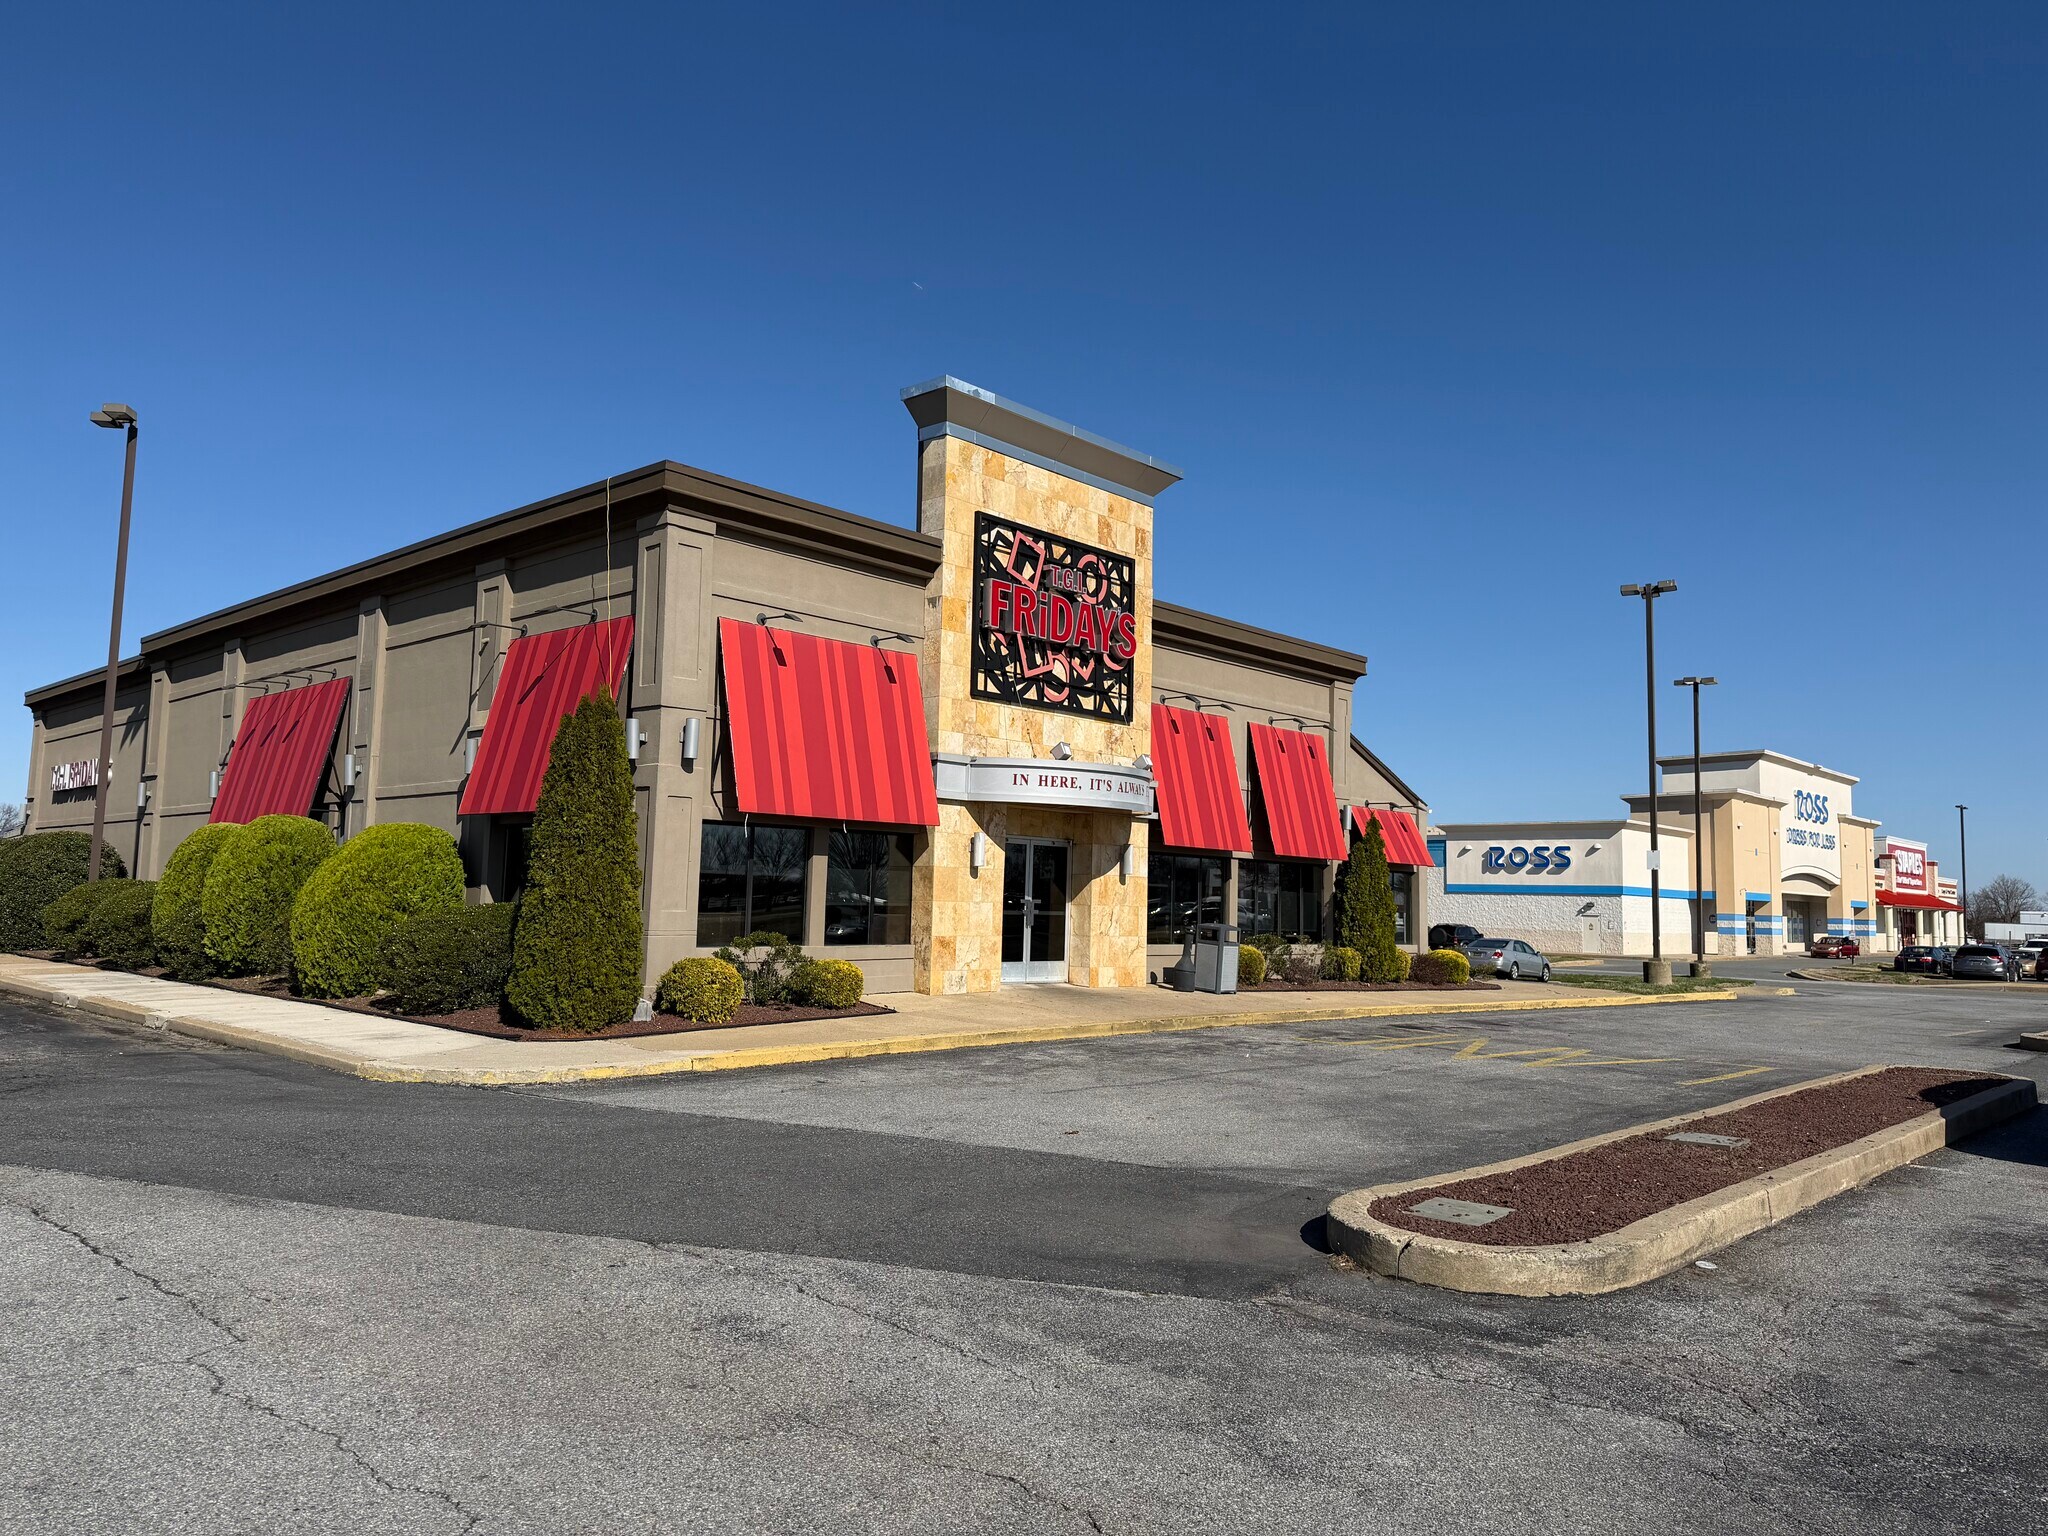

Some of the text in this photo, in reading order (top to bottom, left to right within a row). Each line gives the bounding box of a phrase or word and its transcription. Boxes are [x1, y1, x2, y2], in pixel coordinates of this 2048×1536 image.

[1050, 564, 1088, 595] T.G.I.
[1012, 773, 1030, 787] IN
[1037, 774, 1083, 791] HERE,
[1089, 777, 1113, 792] IT'S
[1794, 789, 1829, 823] ROSS
[1488, 845, 1572, 868] ROSS
[1895, 849, 1923, 876] STAPLES
